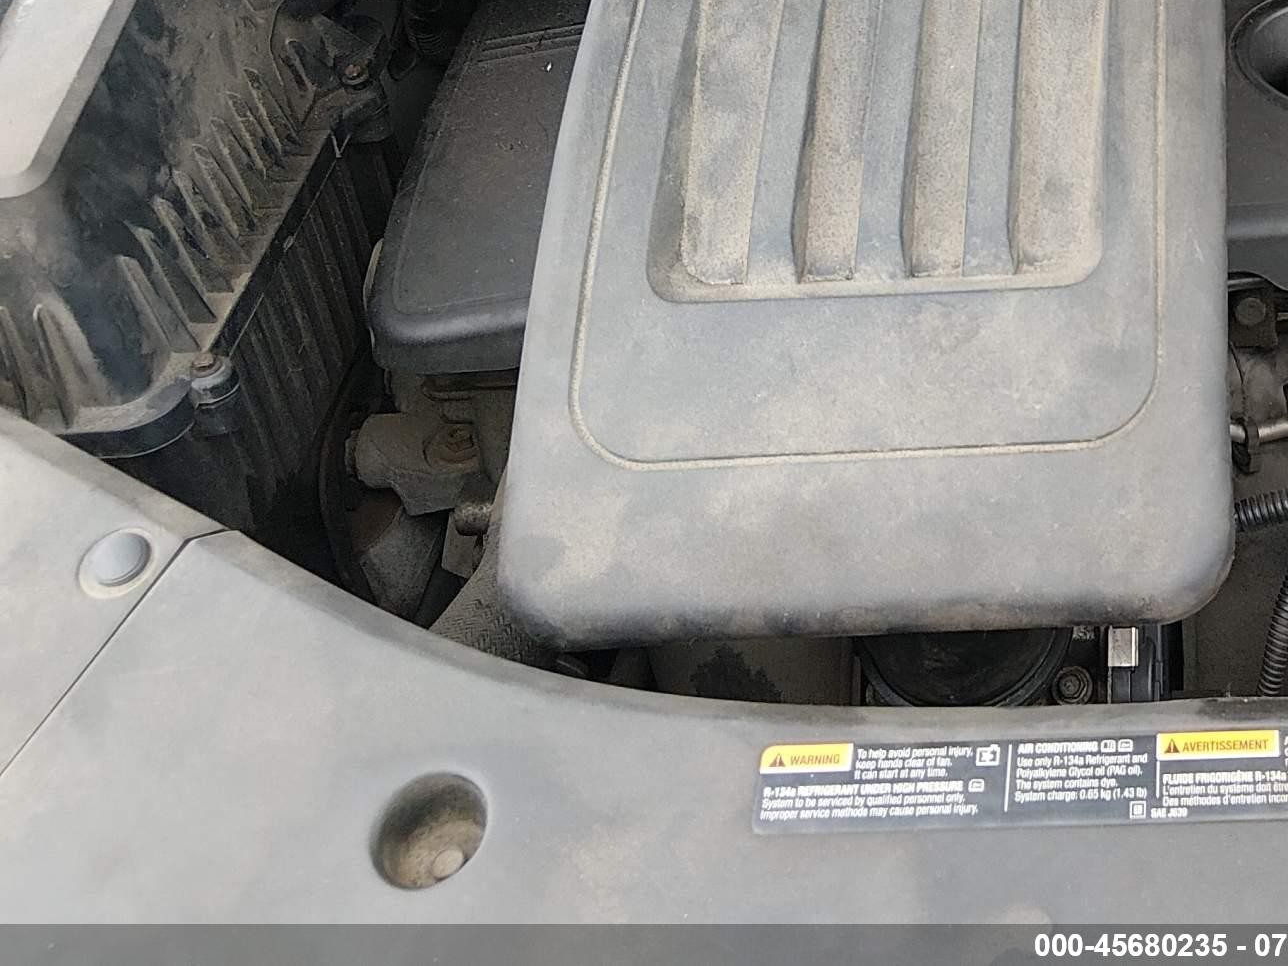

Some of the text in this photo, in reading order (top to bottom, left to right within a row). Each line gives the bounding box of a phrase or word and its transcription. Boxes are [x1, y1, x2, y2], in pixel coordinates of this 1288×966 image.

[857, 749, 866, 759] To
[868, 749, 886, 759] help
[888, 748, 910, 758] avoid
[912, 746, 947, 759] personal
[1018, 741, 1098, 754] AIR CONDITIONING
[1183, 739, 1269, 753] AVERTISSEMENT
[790, 754, 840, 766] WARNING
[856, 756, 952, 770] keep hands clear of fan.
[1017, 754, 1148, 767] Use only R-134a Refrigerant and
[862, 770, 878, 779] can
[879, 768, 898, 779] start
[900, 768, 909, 778] at
[910, 768, 926, 778] any
[1016, 767, 1067, 779] Polyalkylene
[1068, 766, 1094, 777] Glycol
[1095, 766, 1104, 776] oil
[1107, 765, 1126, 776] (PAG
[1162, 772, 1194, 784] FLUIDE
[1255, 770, 1287, 781] R-134a
[763, 780, 963, 797] R-134a REFRIGERANT UNDER HIGH PRESSURE
[1016, 778, 1118, 790] The system contains dye.
[1163, 784, 1206, 796] L'entretien
[1207, 785, 1218, 794] du
[762, 798, 794, 810] System
[795, 798, 804, 807] to
[805, 797, 816, 807] be
[818, 796, 853, 806] serviced
[854, 796, 865, 806] by
[867, 794, 903, 805] qualified
[904, 793, 944, 805] personnel
[1014, 788, 1147, 803] System charge: 0.65 kg (1.43 lb)
[1163, 796, 1179, 807] Des
[1223, 794, 1267, 805] d'entretien
[760, 810, 799, 822] Improper
[800, 809, 830, 818] service
[832, 808, 868, 818] methods
[870, 807, 888, 818] may
[889, 806, 915, 816] cause
[916, 804, 952, 816] personal
